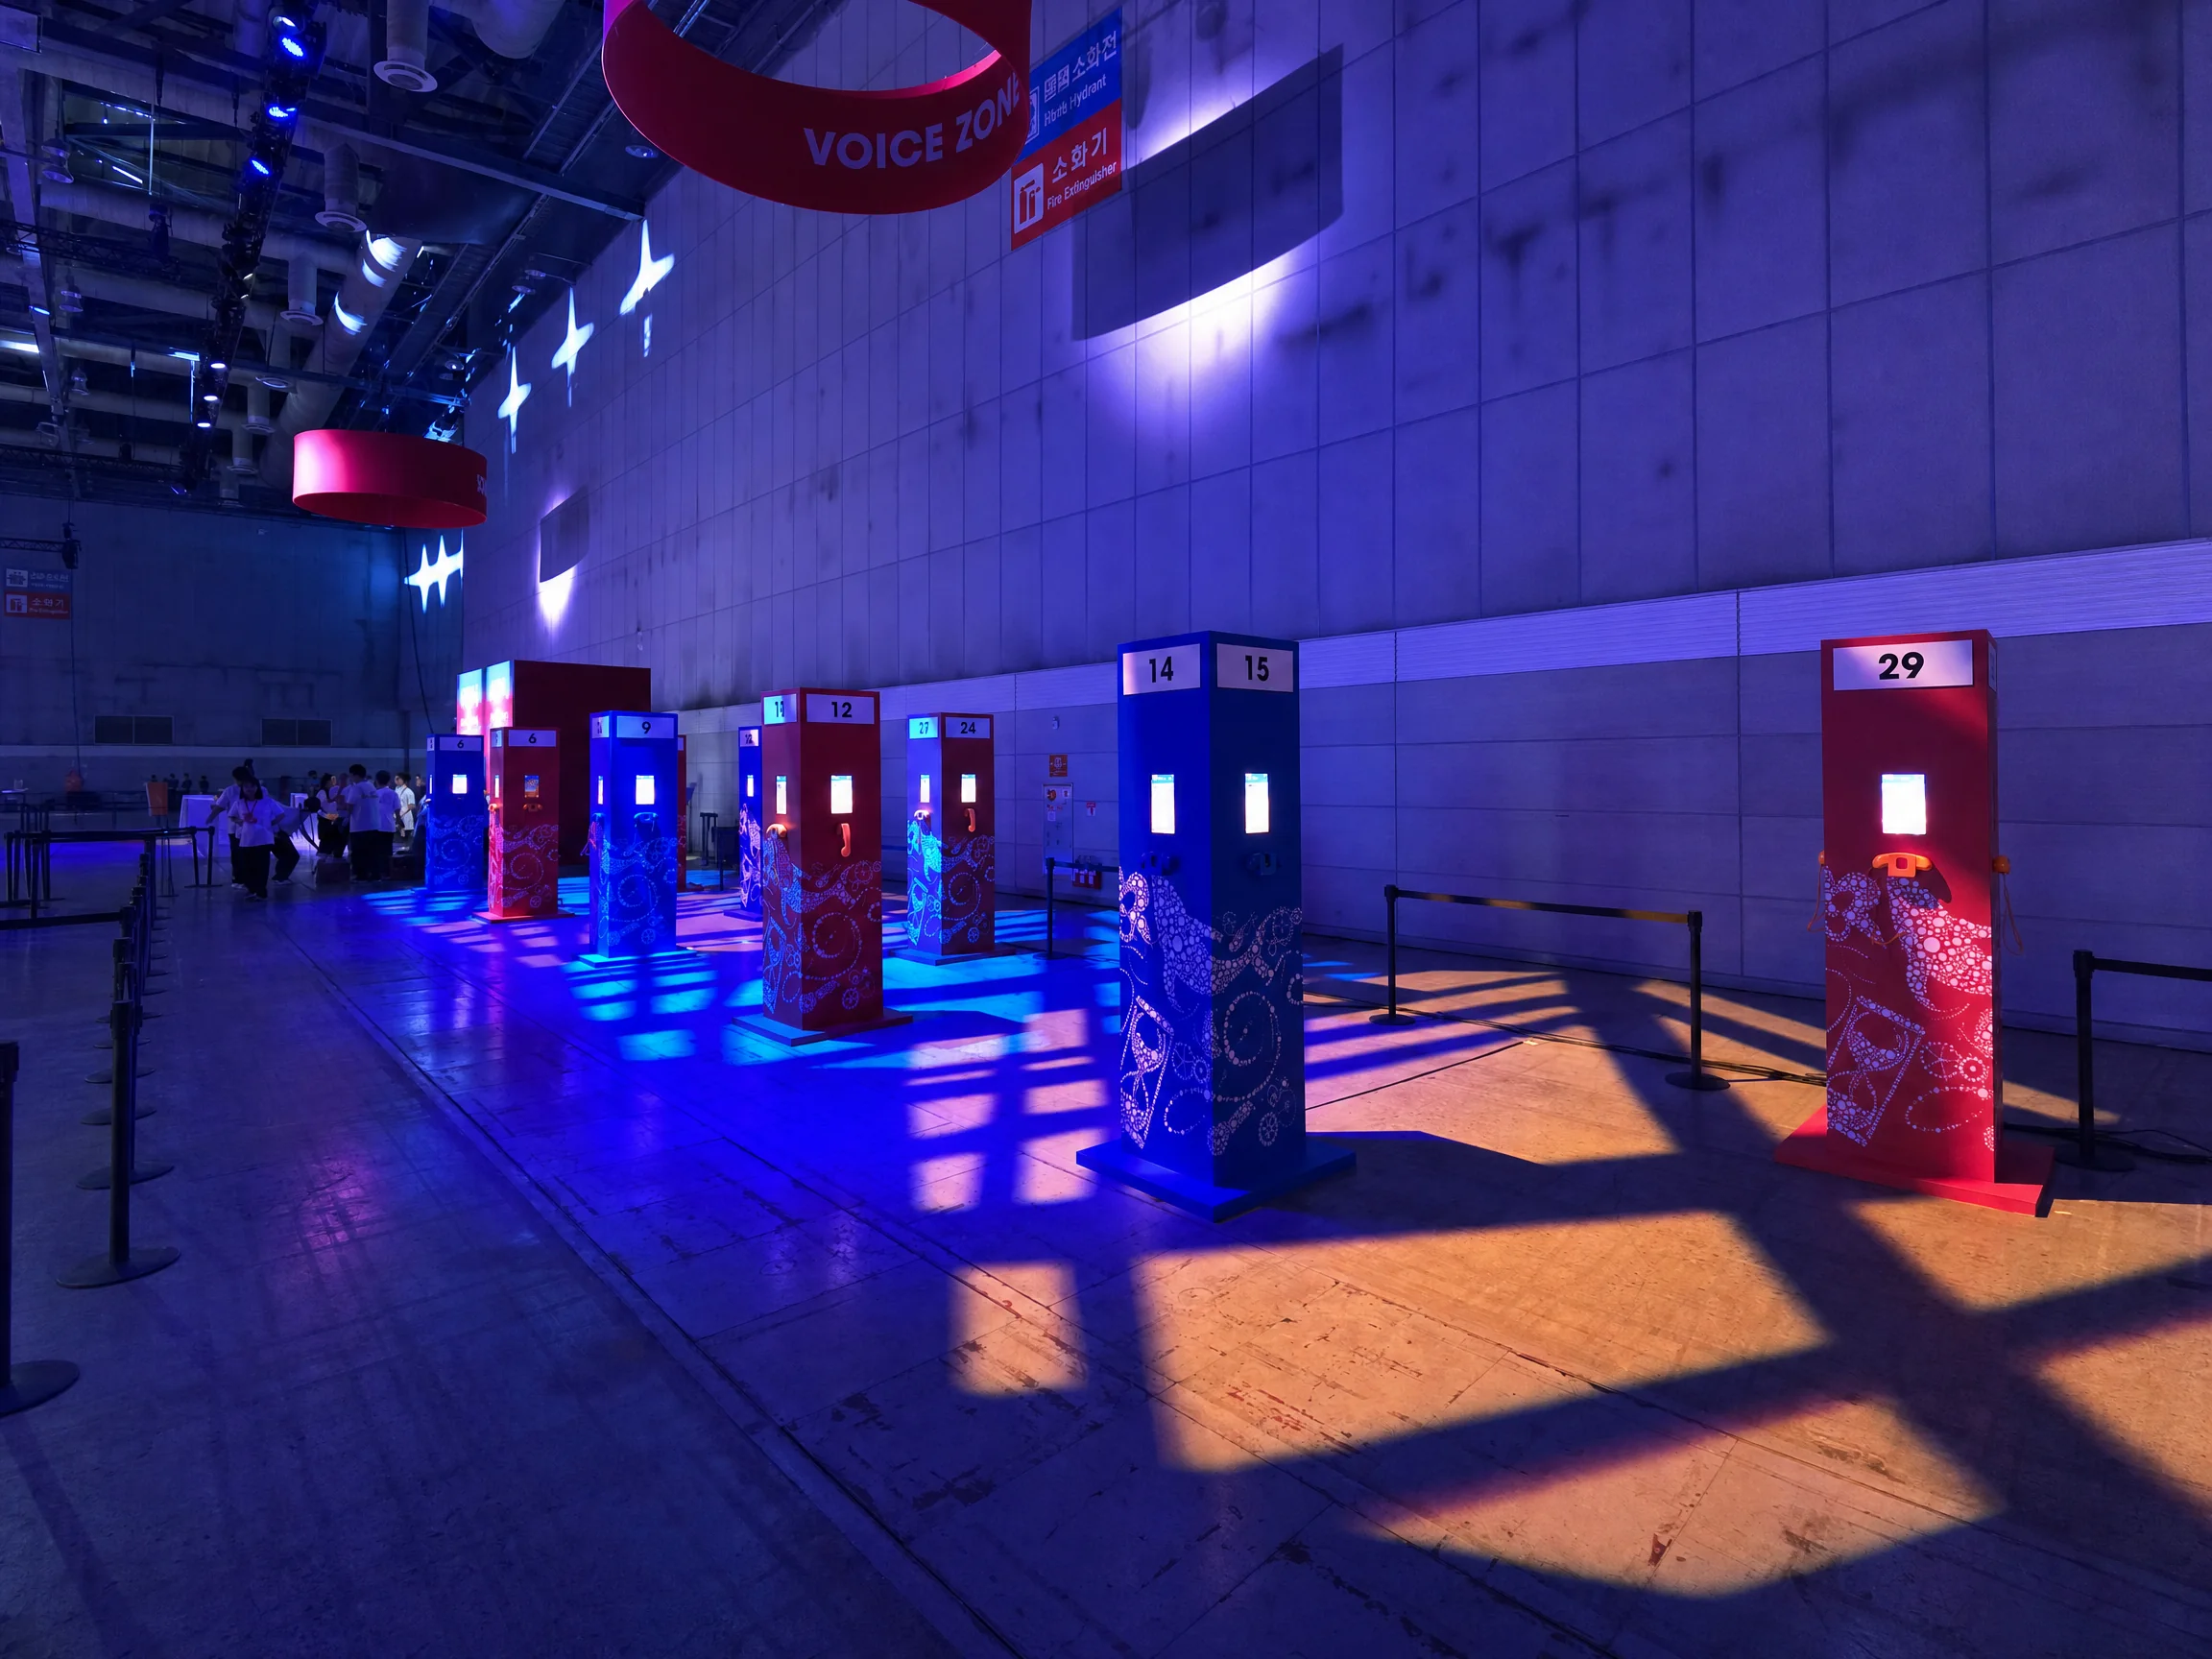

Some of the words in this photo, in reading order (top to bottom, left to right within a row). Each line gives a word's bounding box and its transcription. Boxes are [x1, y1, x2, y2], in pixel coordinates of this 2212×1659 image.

[1070, 74, 1107, 109] Hydrant
[804, 123, 944, 170] VOICE
[955, 72, 1021, 154] ZONE
[1051, 127, 1107, 184] 소화기
[1046, 195, 1063, 210] Fire
[1063, 161, 1118, 201] Extinguisher
[1148, 655, 1174, 684] 14
[1244, 655, 1270, 682] 15
[1878, 651, 1925, 681] 29
[830, 701, 854, 718] 12
[528, 733, 538, 744] 6
[641, 720, 652, 734] 9
[919, 721, 929, 734] 27
[960, 721, 976, 734] 24
[456, 739, 465, 749] 6
